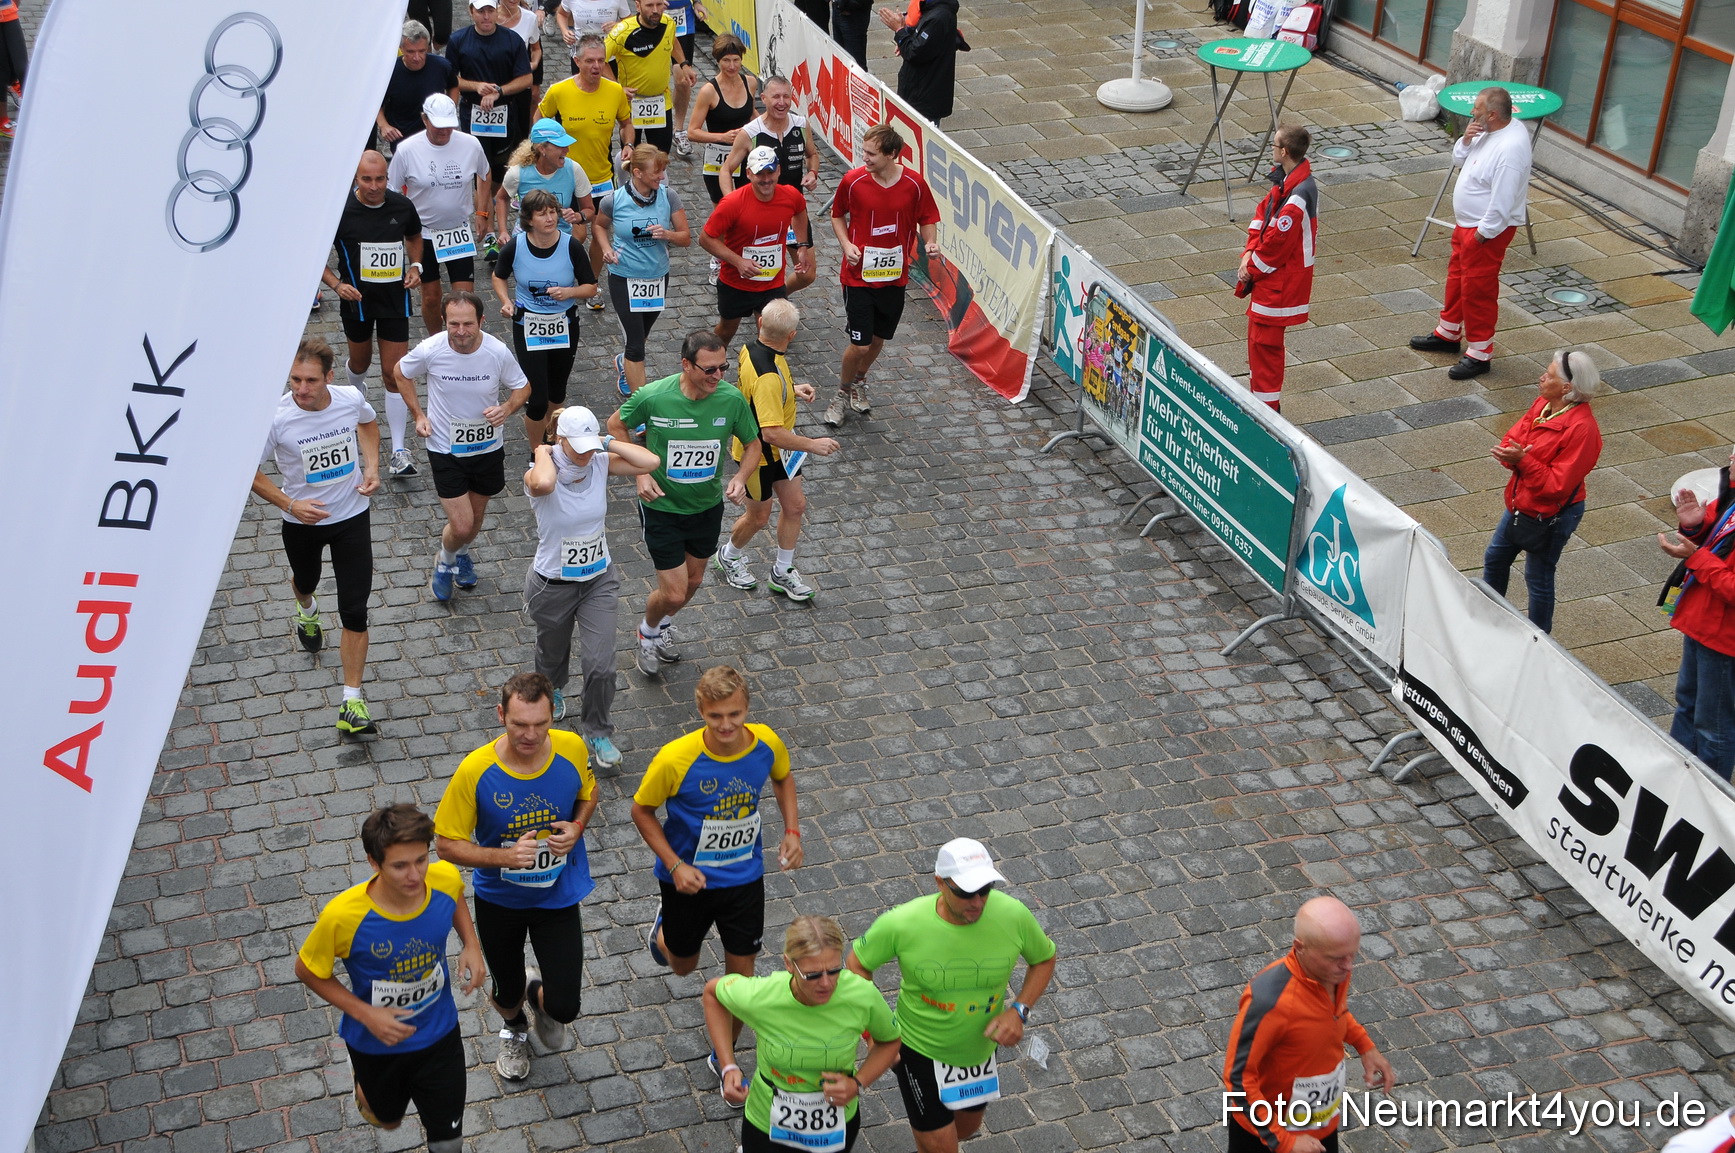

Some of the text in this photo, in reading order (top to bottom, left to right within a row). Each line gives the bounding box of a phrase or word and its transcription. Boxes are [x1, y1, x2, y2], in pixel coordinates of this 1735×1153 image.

[475, 111, 504, 124] 2328
[639, 104, 659, 116] 292
[436, 230, 470, 247] 2706
[370, 253, 396, 267] 200
[752, 254, 775, 267] 253
[873, 256, 896, 268] 155
[937, 221, 1020, 334] LASTERSTEINE
[632, 284, 660, 297] 2301
[529, 321, 564, 336] 2586
[1170, 367, 1239, 434] Event-Leit-Systeme
[297, 426, 350, 445] www.hasit.de
[455, 425, 494, 442] 2689
[1148, 388, 1239, 484] Mehr Sicherheit
[321, 440, 345, 450] Neumarkt
[309, 445, 350, 471] 2561
[673, 450, 715, 467] 2729
[1146, 414, 1221, 496] für Ihr Event!
[1144, 450, 1253, 559] Miet & Service Line: 09181 6352
[568, 541, 603, 564] 2374
[43, 332, 198, 794] Audi BKK
[1300, 581, 1329, 609] Gebäude
[1330, 602, 1354, 626] Service
[1355, 621, 1376, 644] GmbH
[1403, 682, 1513, 797] istungen, die verbinden
[704, 827, 755, 850] 2603
[520, 873, 552, 882] Herbert
[1546, 816, 1696, 964] stadtwerke
[381, 980, 438, 1008] 2604
[959, 1086, 983, 1098] Benno
[778, 1105, 838, 1131] 2383
[788, 1132, 829, 1146] Theresia
